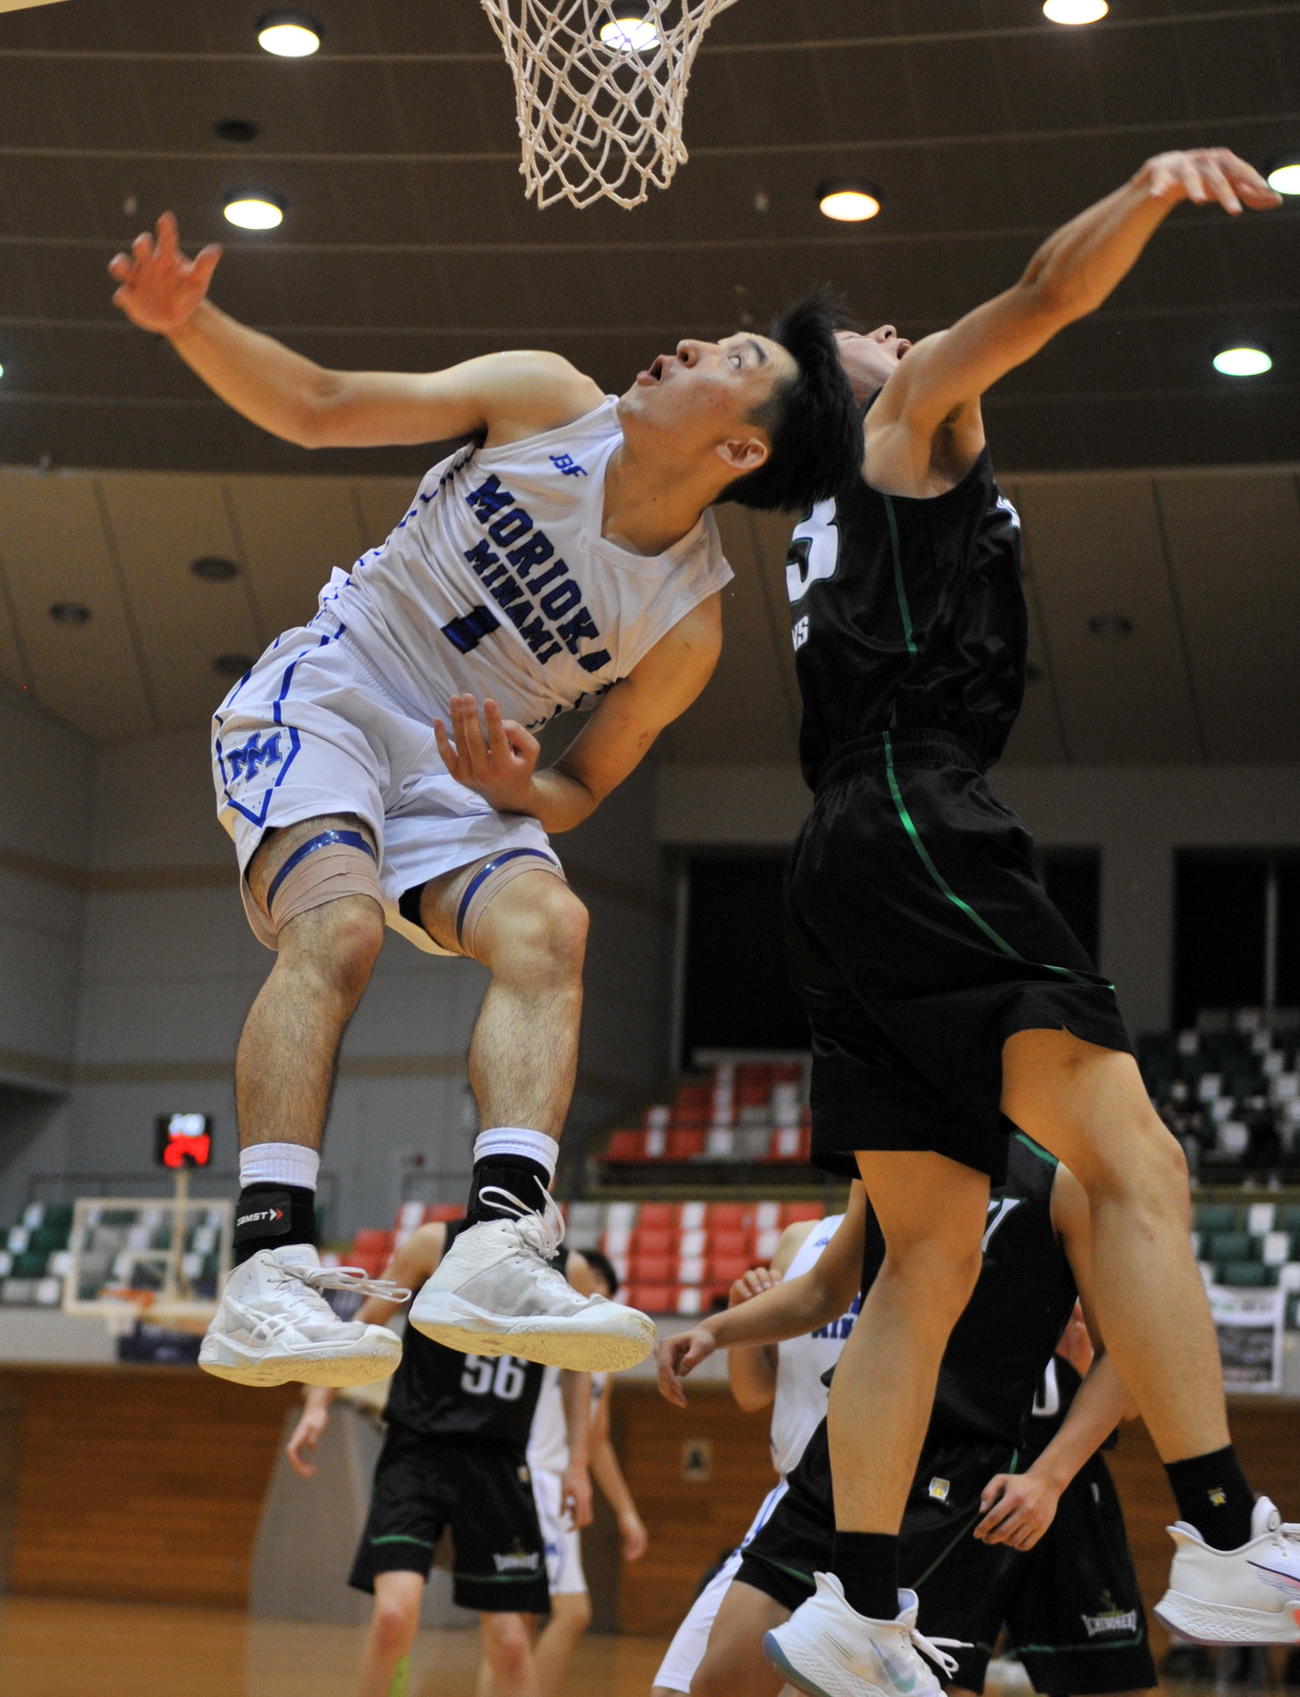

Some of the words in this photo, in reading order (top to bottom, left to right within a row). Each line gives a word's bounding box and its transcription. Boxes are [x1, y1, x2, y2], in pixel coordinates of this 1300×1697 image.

[464, 538, 563, 665] MINAMI
[465, 473, 612, 673] MORIOKA
[461, 1353, 529, 1400] 56
